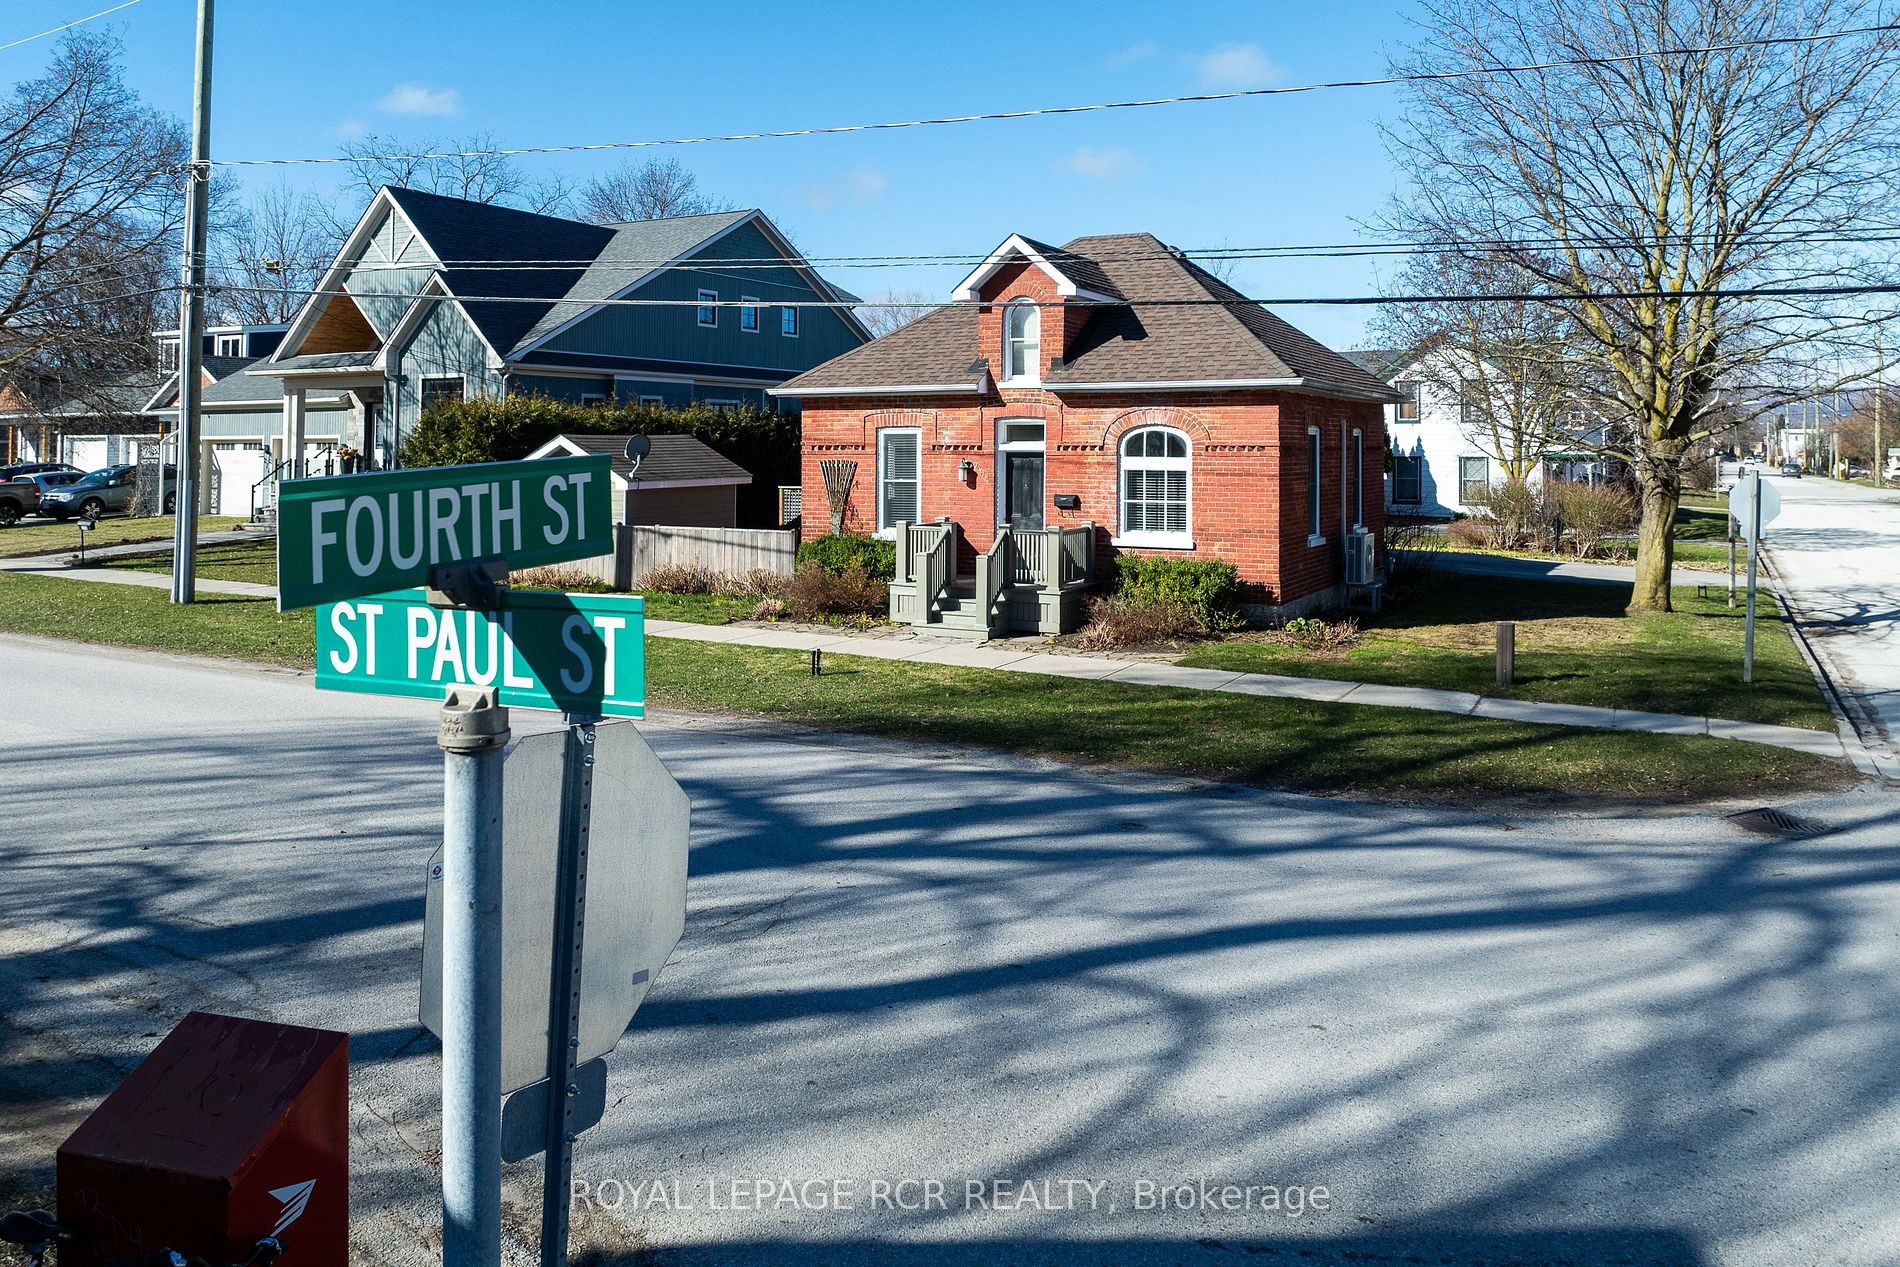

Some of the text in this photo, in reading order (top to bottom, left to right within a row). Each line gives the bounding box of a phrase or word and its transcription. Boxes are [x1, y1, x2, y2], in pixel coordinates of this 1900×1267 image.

[311, 471, 592, 585] FOURTH ST
[329, 600, 626, 696] ST PAUL ST
